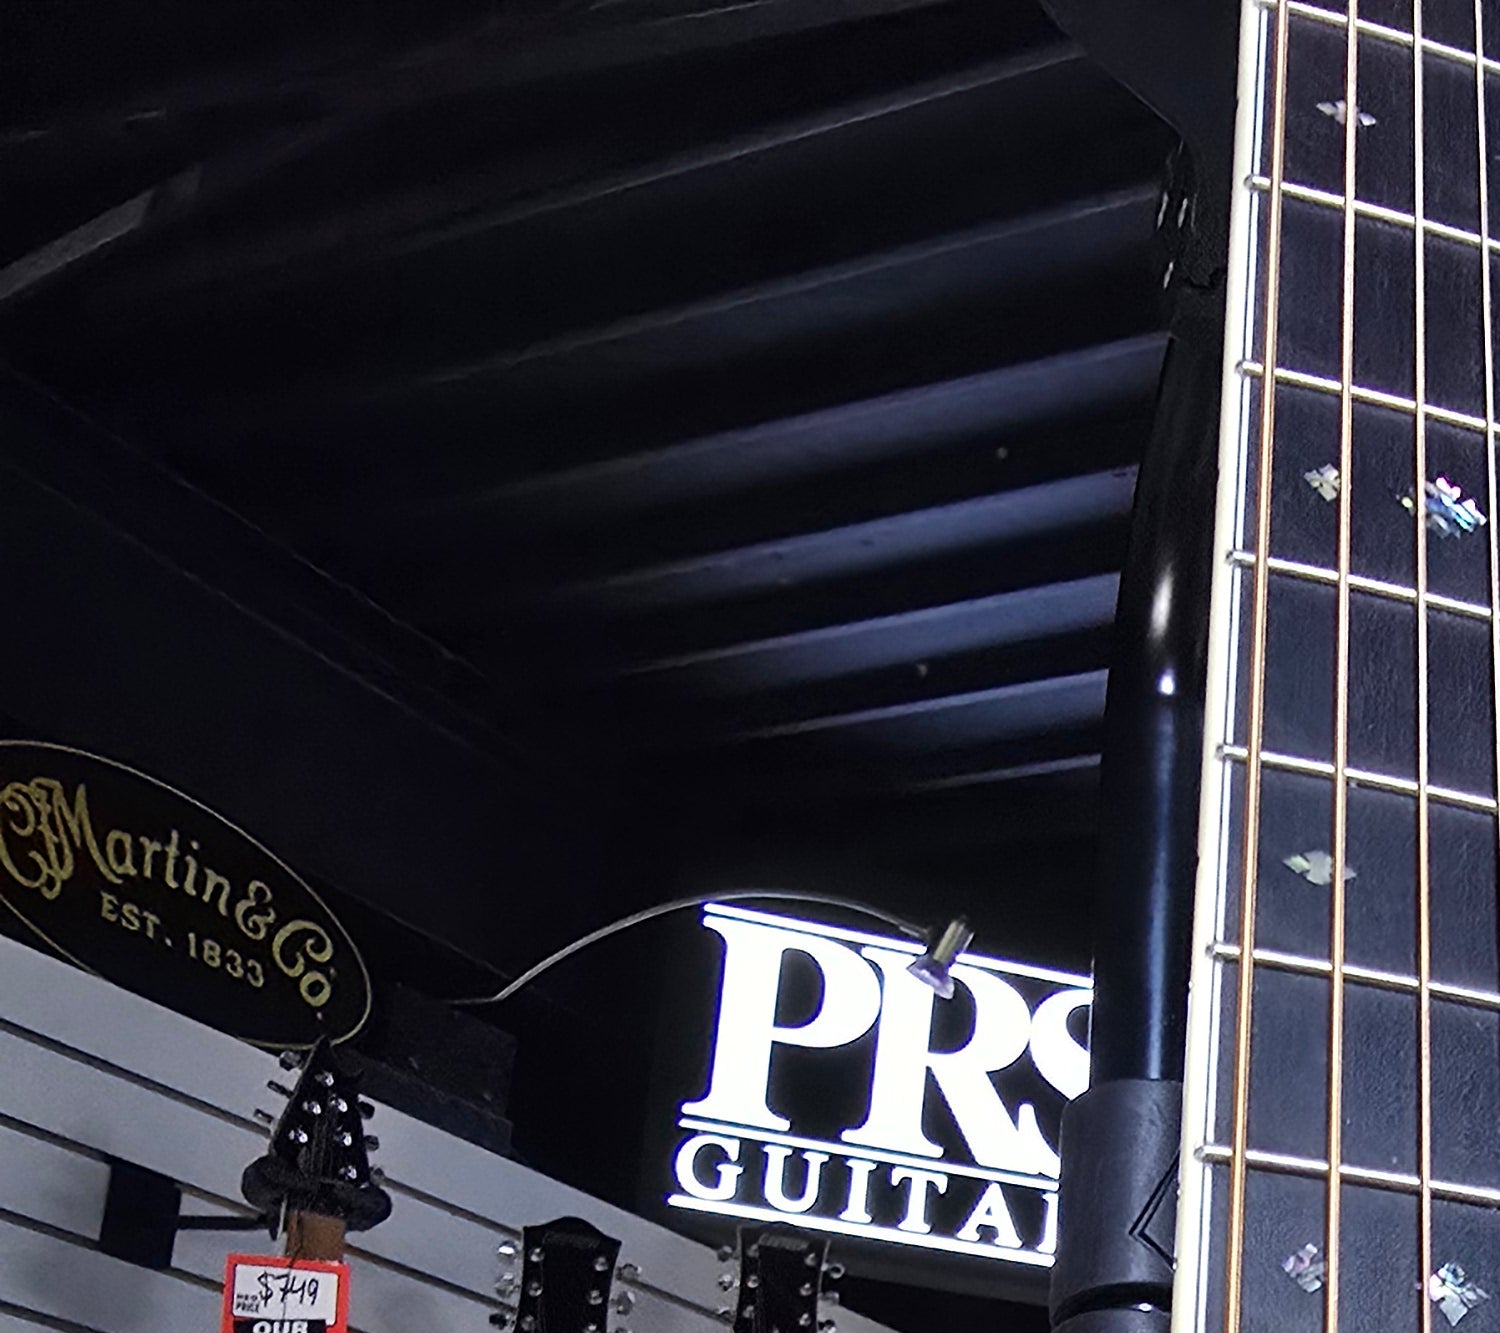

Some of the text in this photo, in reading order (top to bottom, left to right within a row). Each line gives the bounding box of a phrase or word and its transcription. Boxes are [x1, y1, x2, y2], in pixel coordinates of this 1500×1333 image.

[101, 892, 264, 988] EST. 1833
[257, 1270, 319, 1308] $749
